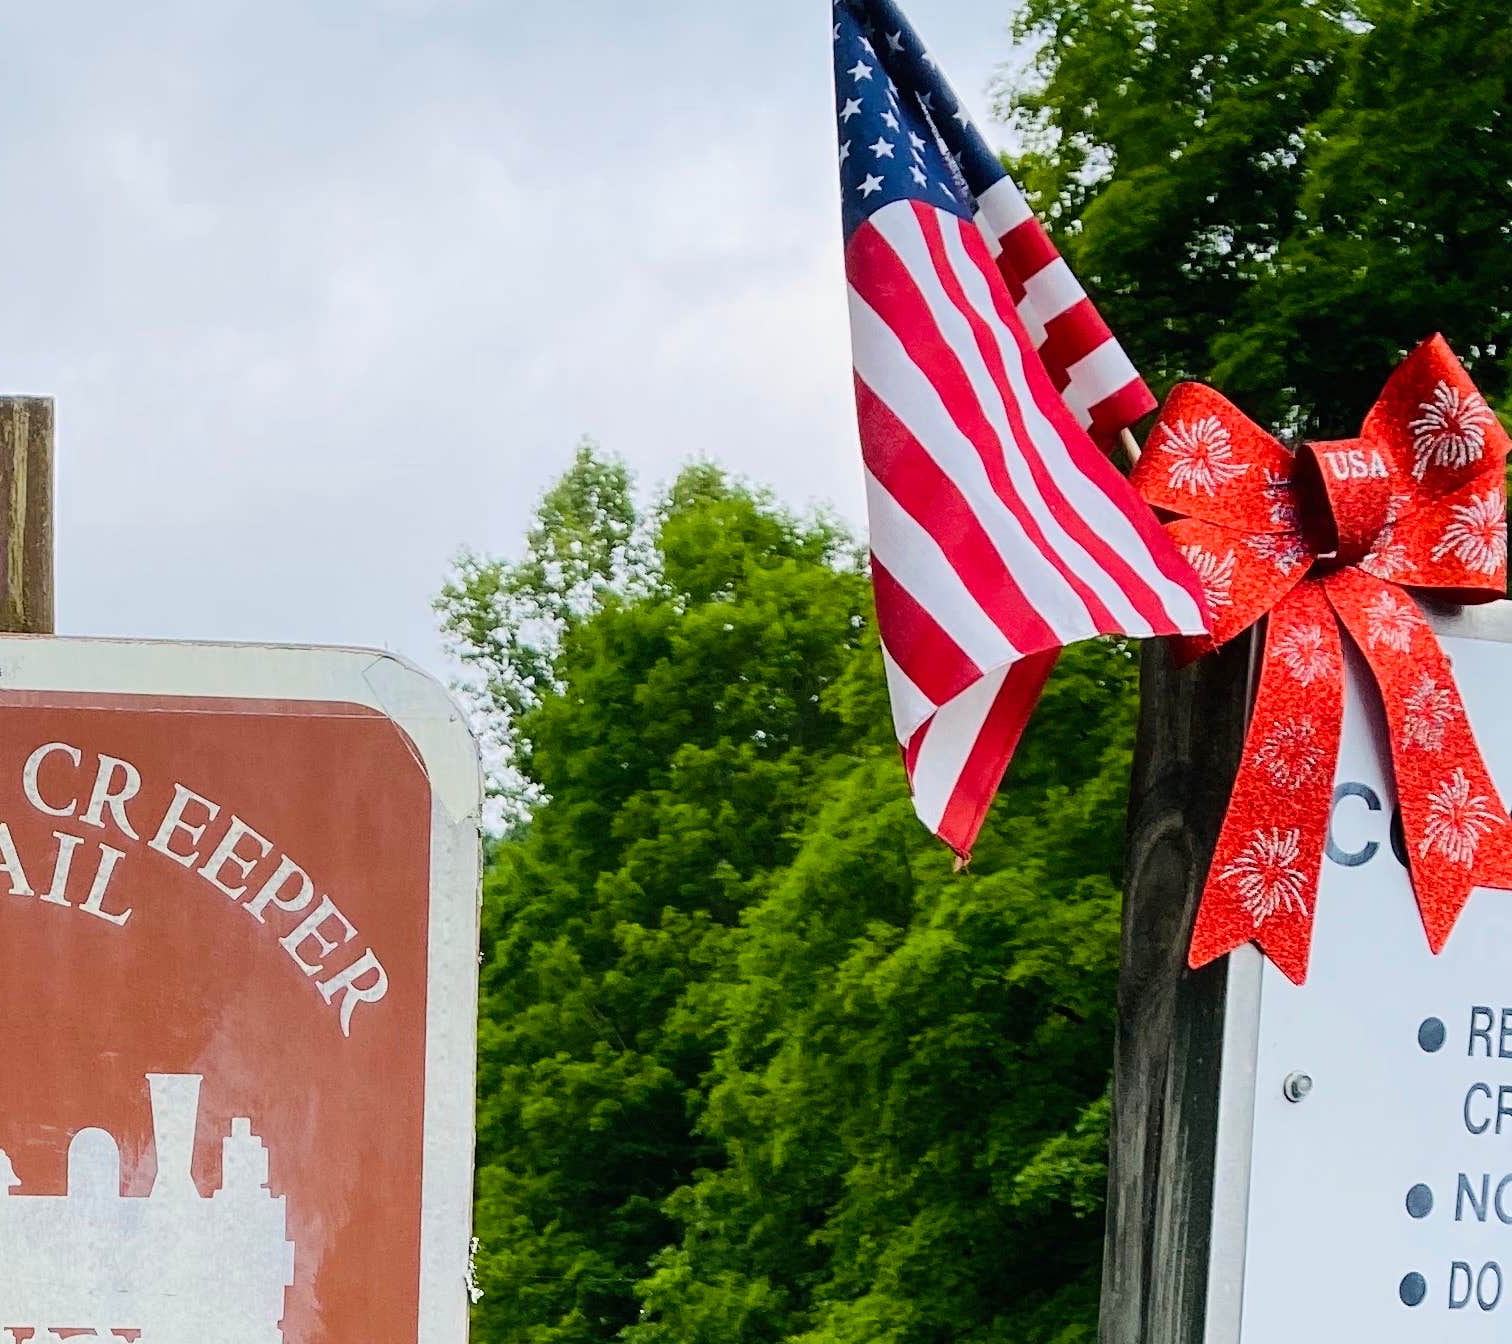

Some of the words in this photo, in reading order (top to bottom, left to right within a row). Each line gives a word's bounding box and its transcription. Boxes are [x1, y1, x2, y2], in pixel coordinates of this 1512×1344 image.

[1323, 449, 1390, 480] USA
[22, 740, 391, 1037] CREEPER
[1447, 1260, 1503, 1312] DO
